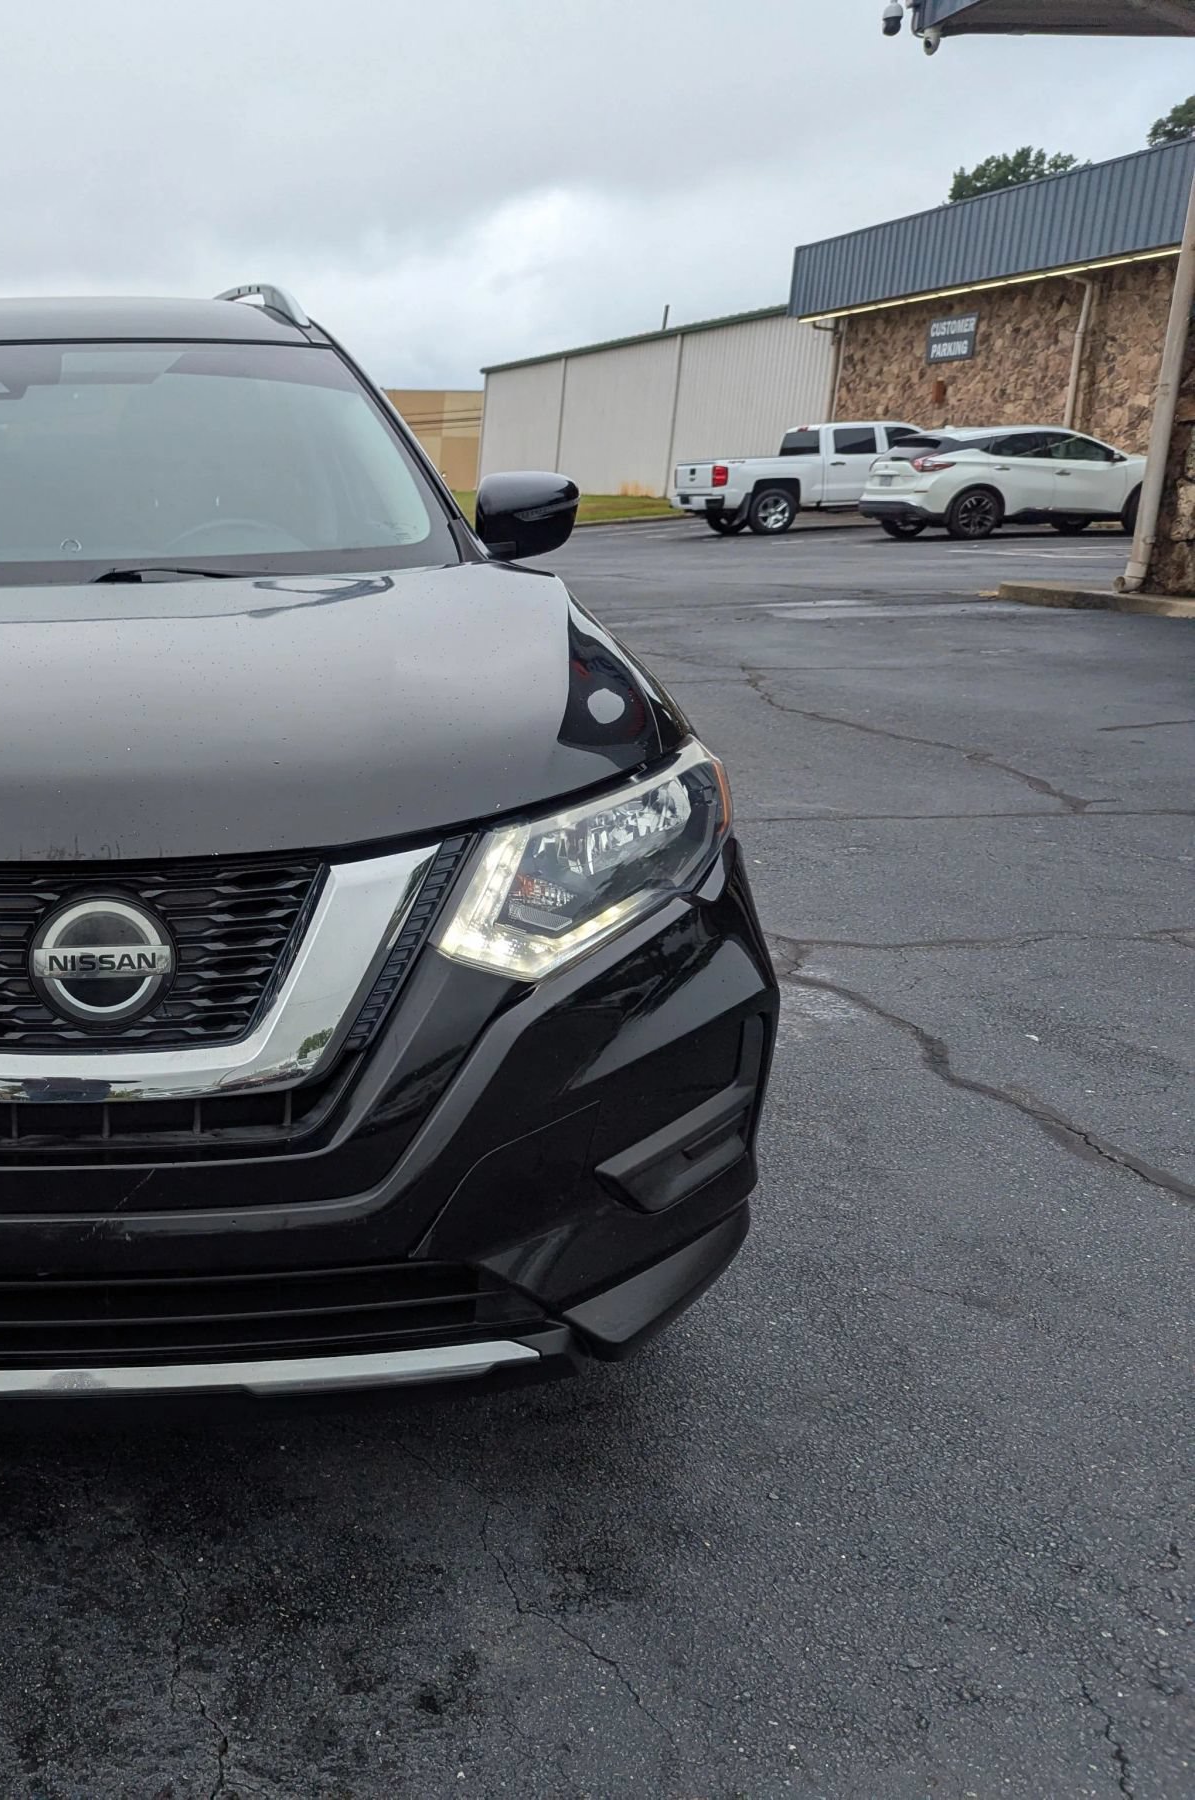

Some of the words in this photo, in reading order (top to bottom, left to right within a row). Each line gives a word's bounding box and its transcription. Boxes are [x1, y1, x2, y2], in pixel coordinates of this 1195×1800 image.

[930, 317, 975, 337] CUSTOMER
[930, 340, 968, 359] PARKING
[48, 952, 157, 972] NISSAN
